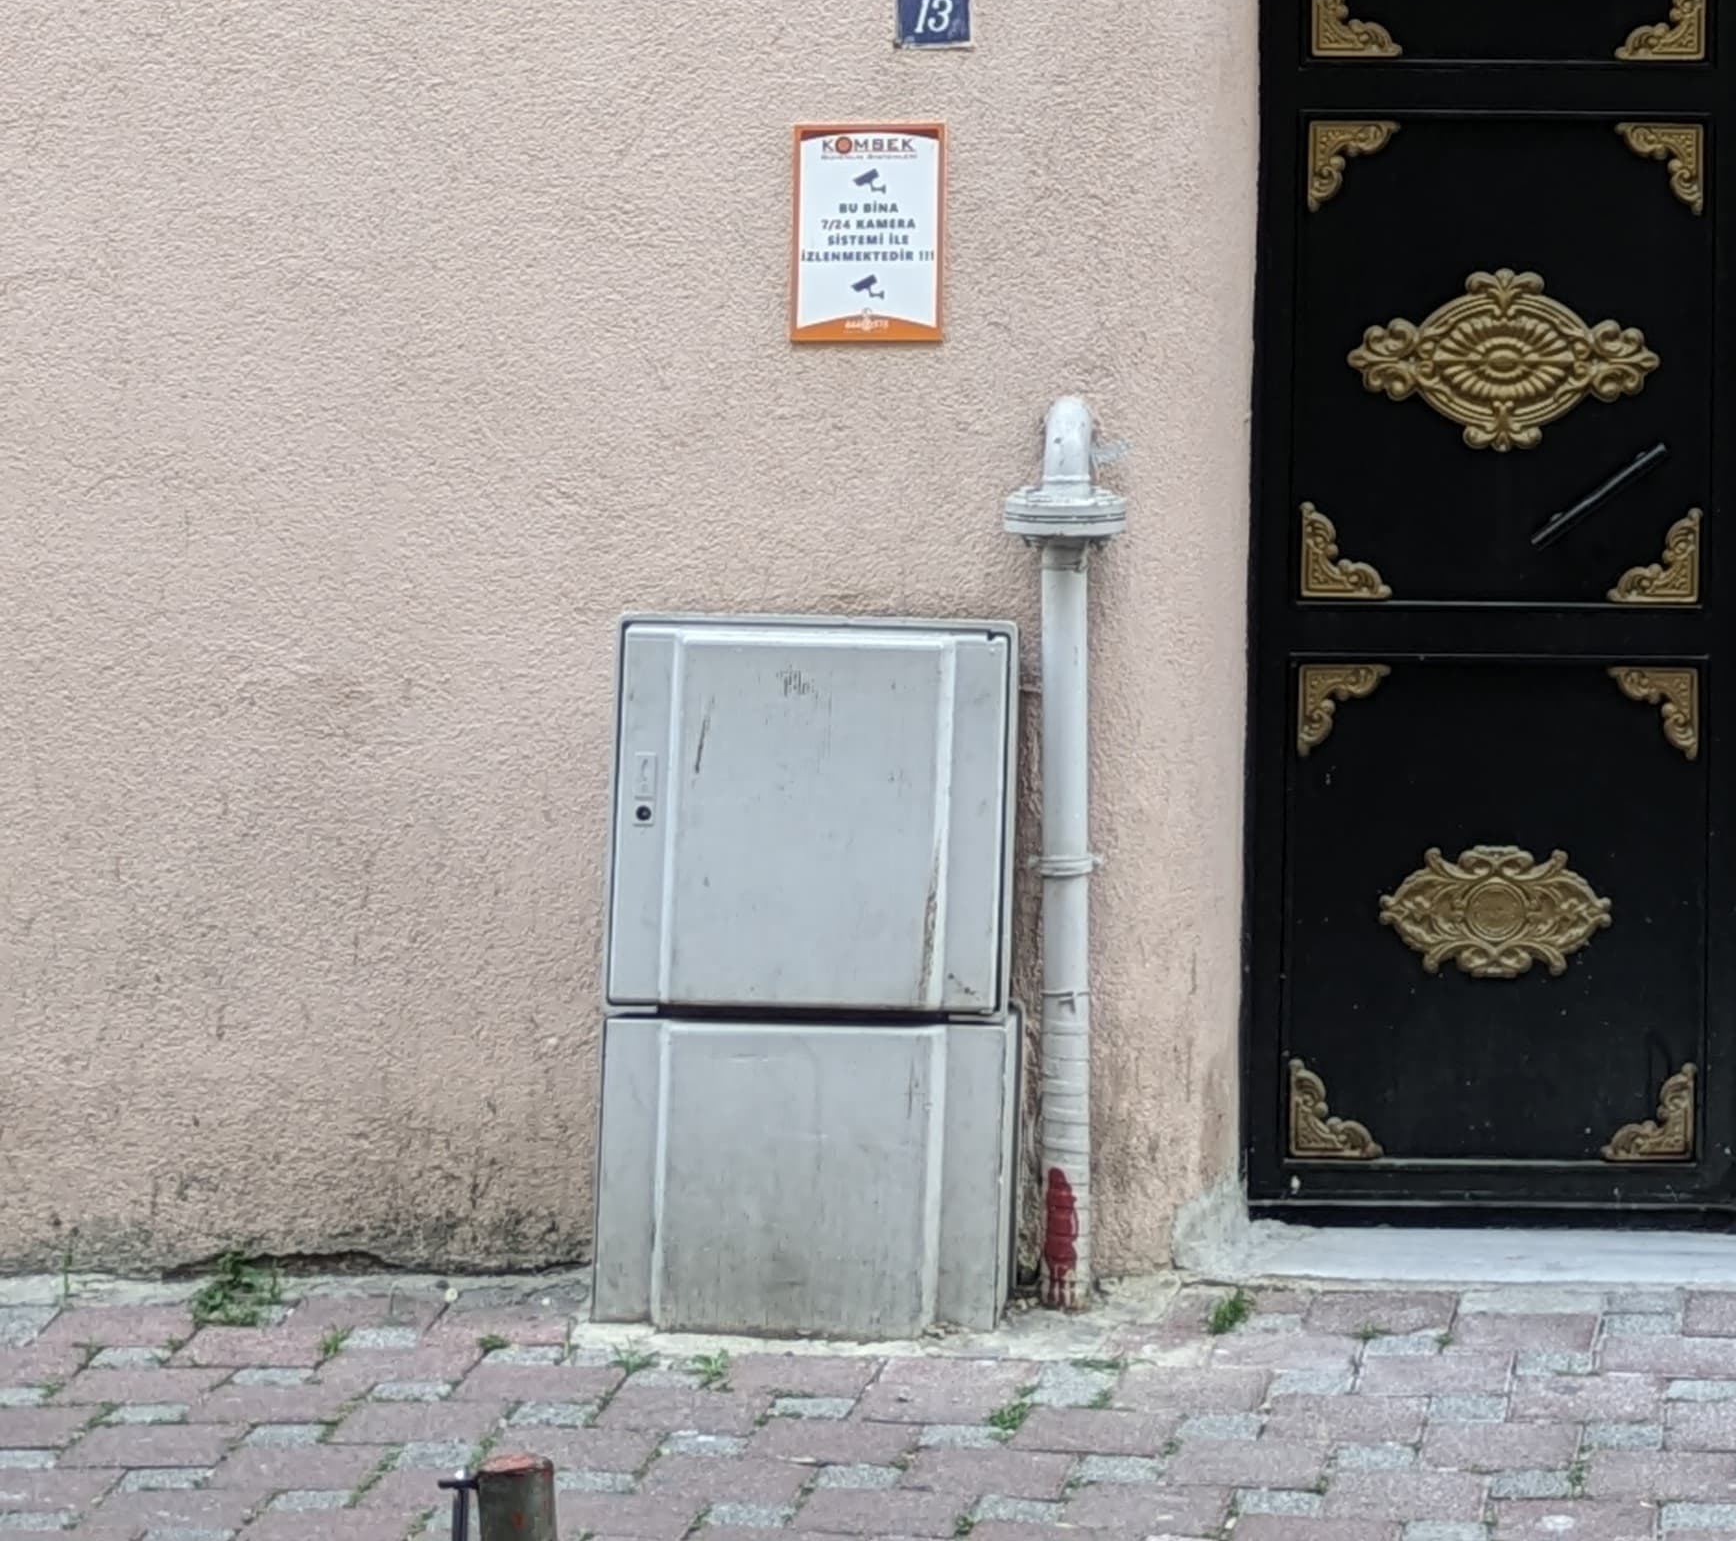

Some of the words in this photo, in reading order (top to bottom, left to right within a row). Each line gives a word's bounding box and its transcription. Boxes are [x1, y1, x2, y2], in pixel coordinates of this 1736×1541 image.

[839, 203, 858, 213] BU
[863, 200, 899, 213] BİNA
[821, 219, 851, 230] 7/24
[856, 218, 916, 229] KAMERA
[827, 233, 884, 246] SİSTEMİ
[889, 233, 909, 245] İLE
[801, 248, 914, 262] İZLENMEKTEDİR
